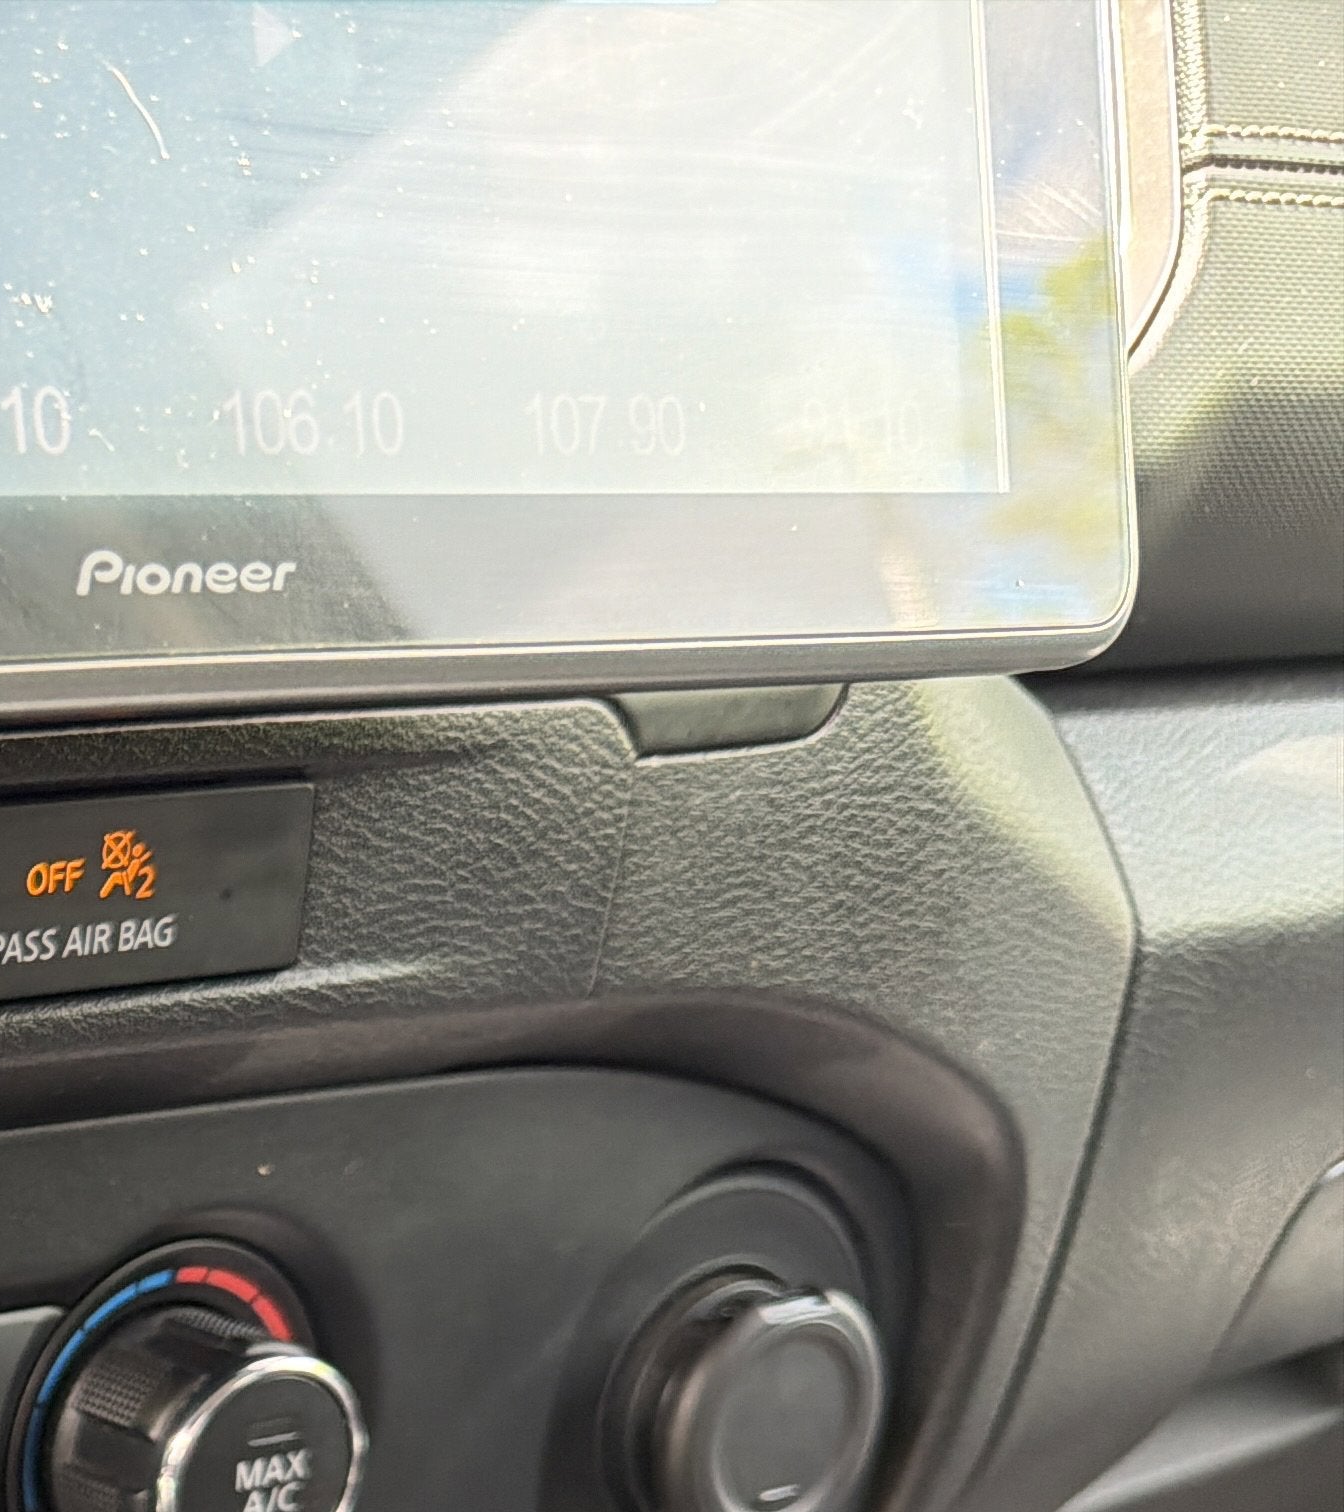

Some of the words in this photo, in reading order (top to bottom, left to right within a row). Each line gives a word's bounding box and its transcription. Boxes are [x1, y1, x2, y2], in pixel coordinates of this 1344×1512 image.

[223, 389, 404, 456] 106.10
[525, 393, 686, 456] 107.90
[76, 550, 297, 596] Pioneer
[27, 858, 85, 896] OFF
[62, 922, 112, 959] AIR
[117, 914, 178, 952] BAG
[235, 1449, 310, 1492] MAX
